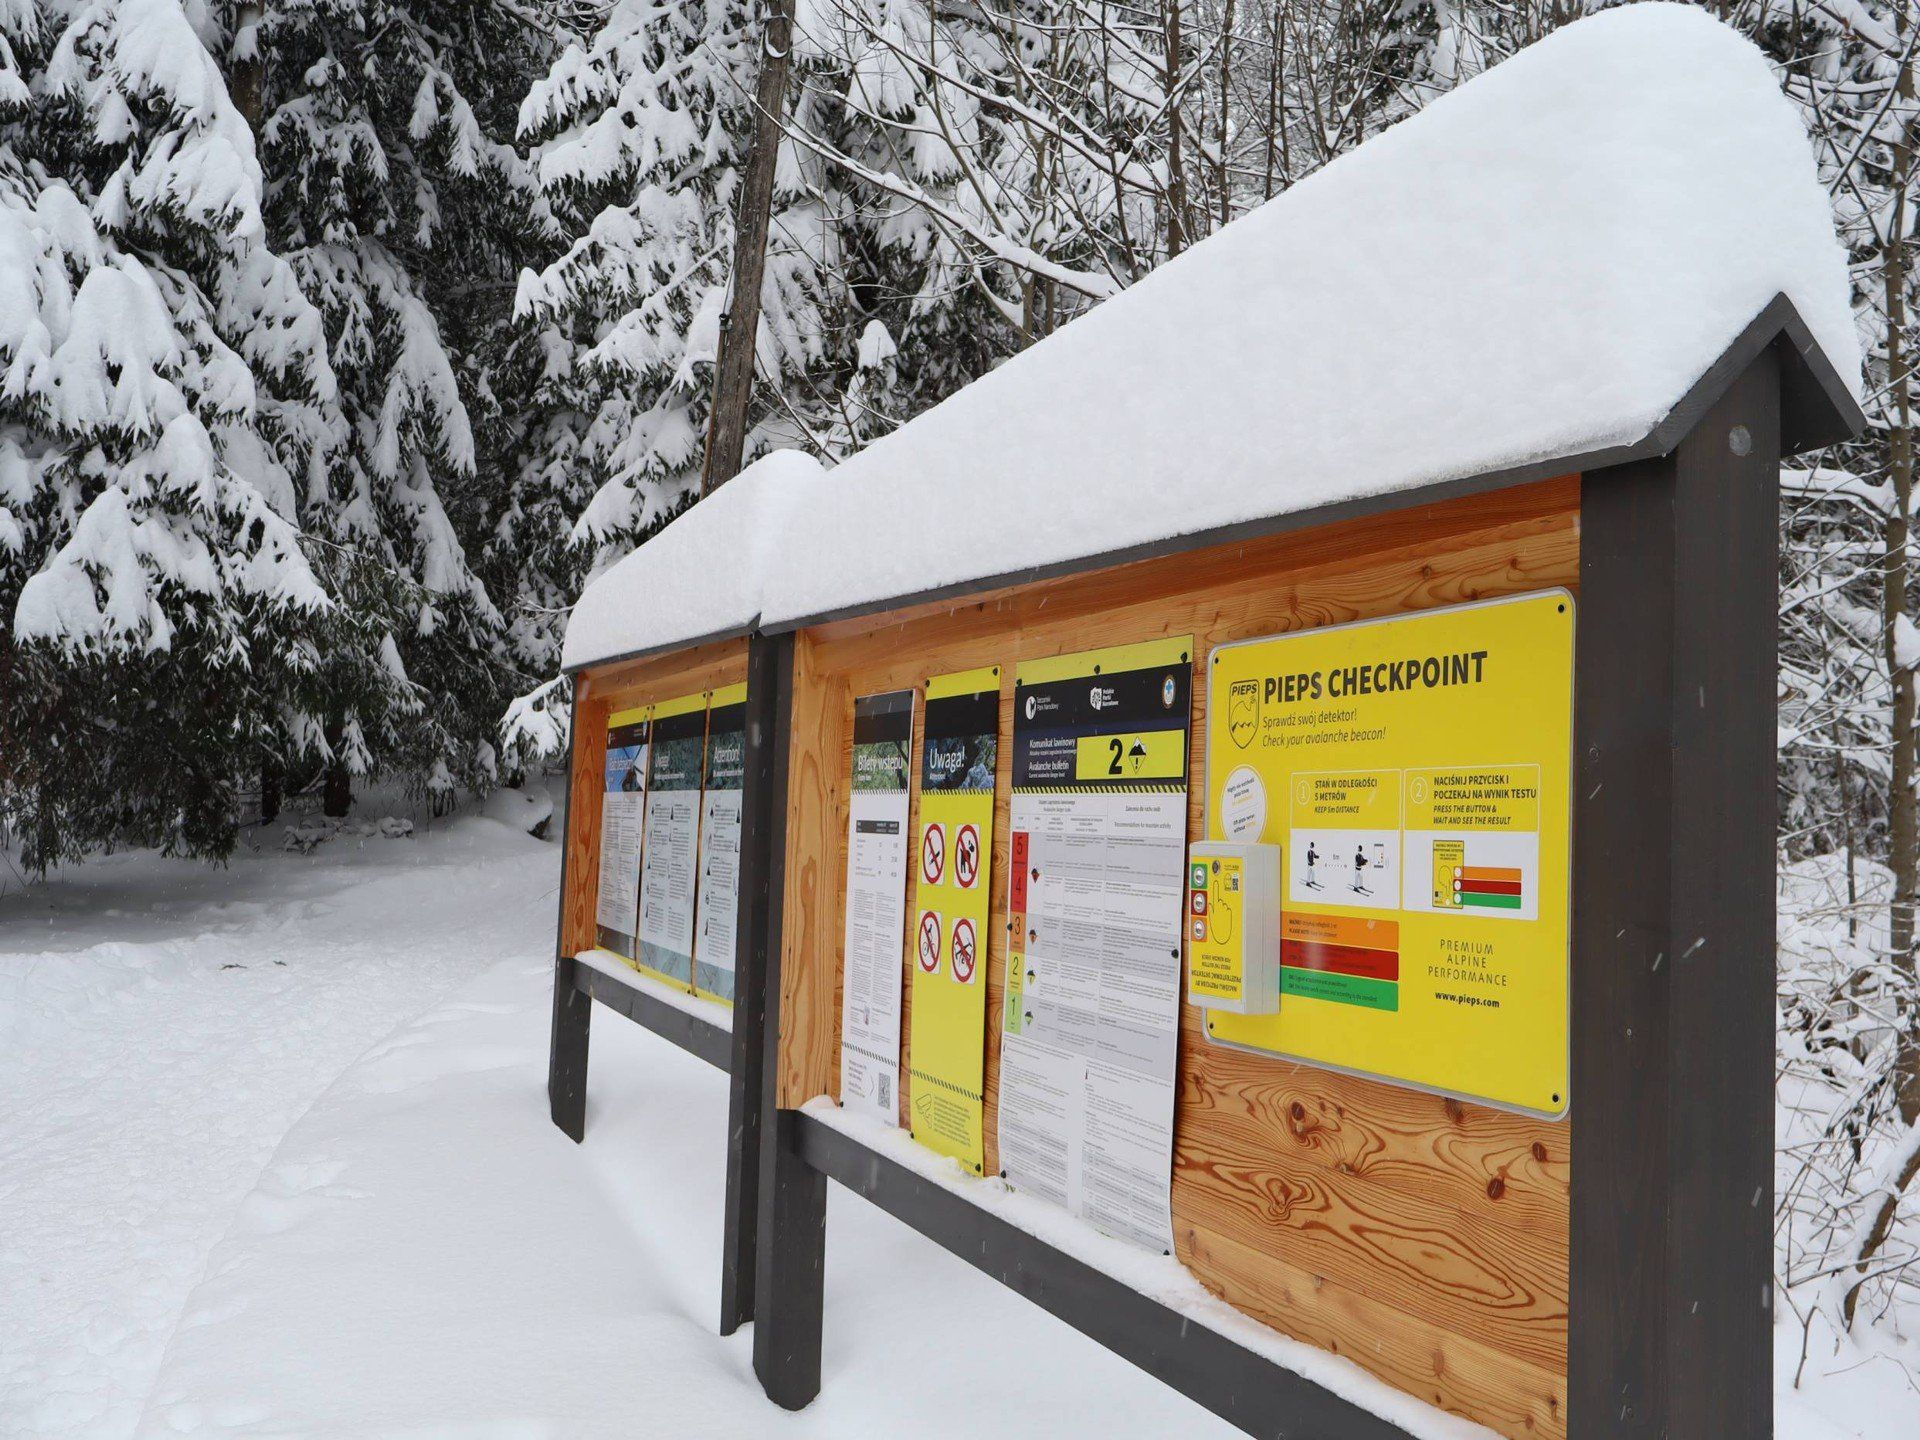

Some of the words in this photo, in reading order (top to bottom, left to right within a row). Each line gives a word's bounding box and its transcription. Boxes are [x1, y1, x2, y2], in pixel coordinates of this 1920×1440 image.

[1264, 672, 1322, 704] PIEPS
[1328, 650, 1488, 698] CHECKPOINT
[1231, 683, 1258, 696] PIEPS
[1262, 713, 1296, 729] Sprawdź
[1298, 711, 1316, 727] swój
[1318, 708, 1357, 725] detektor!
[1262, 733, 1285, 748] Check
[1286, 733, 1304, 749] your
[1305, 730, 1349, 745] avalanche
[1350, 726, 1386, 742] beacon!
[930, 746, 965, 773] Uwaga!
[1108, 738, 1123, 775] 2
[1315, 778, 1330, 789] STAŃ
[1331, 780, 1337, 788] W
[1338, 777, 1378, 788] ODLEGŁOŚCI
[1434, 775, 1467, 786] NACIŚNIJ
[1468, 776, 1504, 785] PRZYCISK
[1315, 792, 1319, 801] 5
[1320, 790, 1347, 801] METRÓW
[1416, 785, 1422, 798] 2
[1434, 790, 1471, 800] POCZEKAJ
[1472, 790, 1483, 799] NA
[1484, 790, 1509, 799] WYNIK
[1511, 788, 1536, 799] TESTU
[1434, 805, 1452, 813] PRESS
[1453, 805, 1465, 813] THE
[1466, 805, 1491, 813] BUTTON
[1434, 817, 1448, 825] WAIT
[1448, 817, 1461, 825] AND
[1462, 817, 1473, 825] SEE
[1475, 817, 1485, 825] THE
[1487, 817, 1511, 825] RESULT
[1017, 836, 1023, 855] 5
[1016, 876, 1021, 895] 4
[1015, 916, 1021, 935] 3
[1440, 939, 1494, 955] PREMIUM
[1013, 956, 1018, 975] 2
[1447, 954, 1486, 968] ALPINE
[1428, 966, 1507, 986] PERFORMANCE
[1012, 996, 1016, 1015] 1
[1435, 992, 1500, 1008] www.pieps.com
